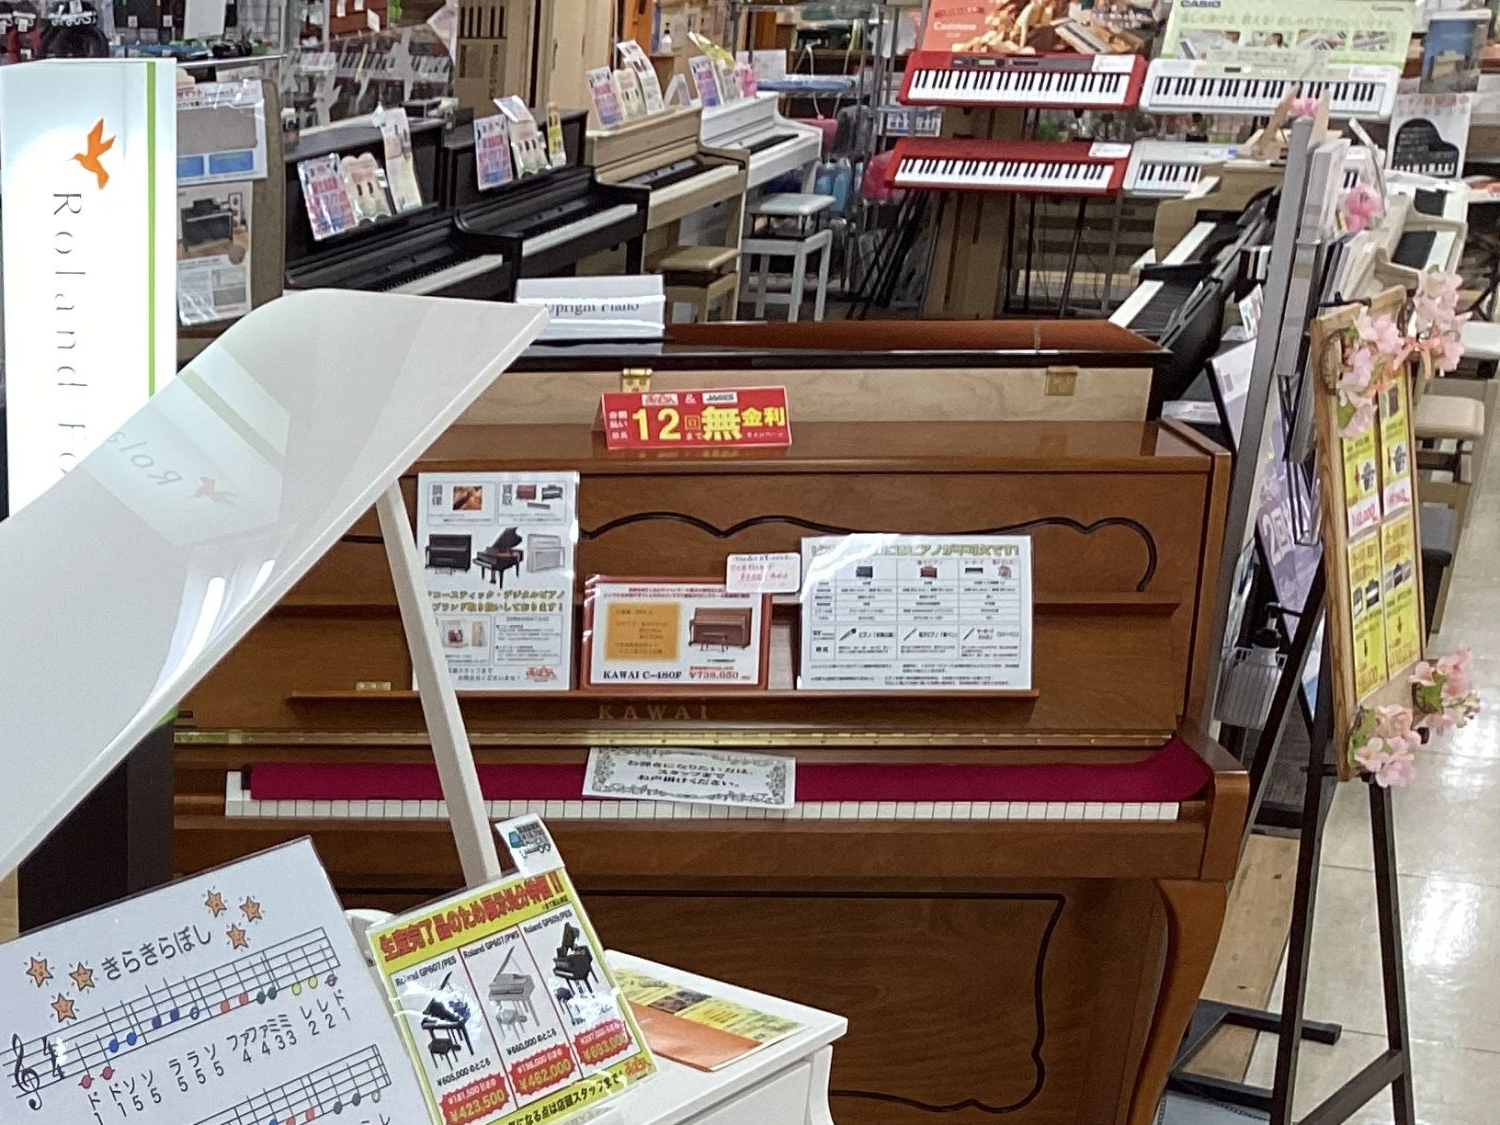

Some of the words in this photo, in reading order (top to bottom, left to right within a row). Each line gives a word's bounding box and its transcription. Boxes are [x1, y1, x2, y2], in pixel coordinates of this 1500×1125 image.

[52, 193, 88, 387] Roland
[632, 408, 682, 441] 12
[603, 670, 641, 680] KAWAI
[599, 704, 708, 721] KAWAI
[100, 923, 213, 982] きらきらぼし
[518, 1058, 572, 1092] ¥462,000
[450, 1088, 506, 1123] ¥423,500
